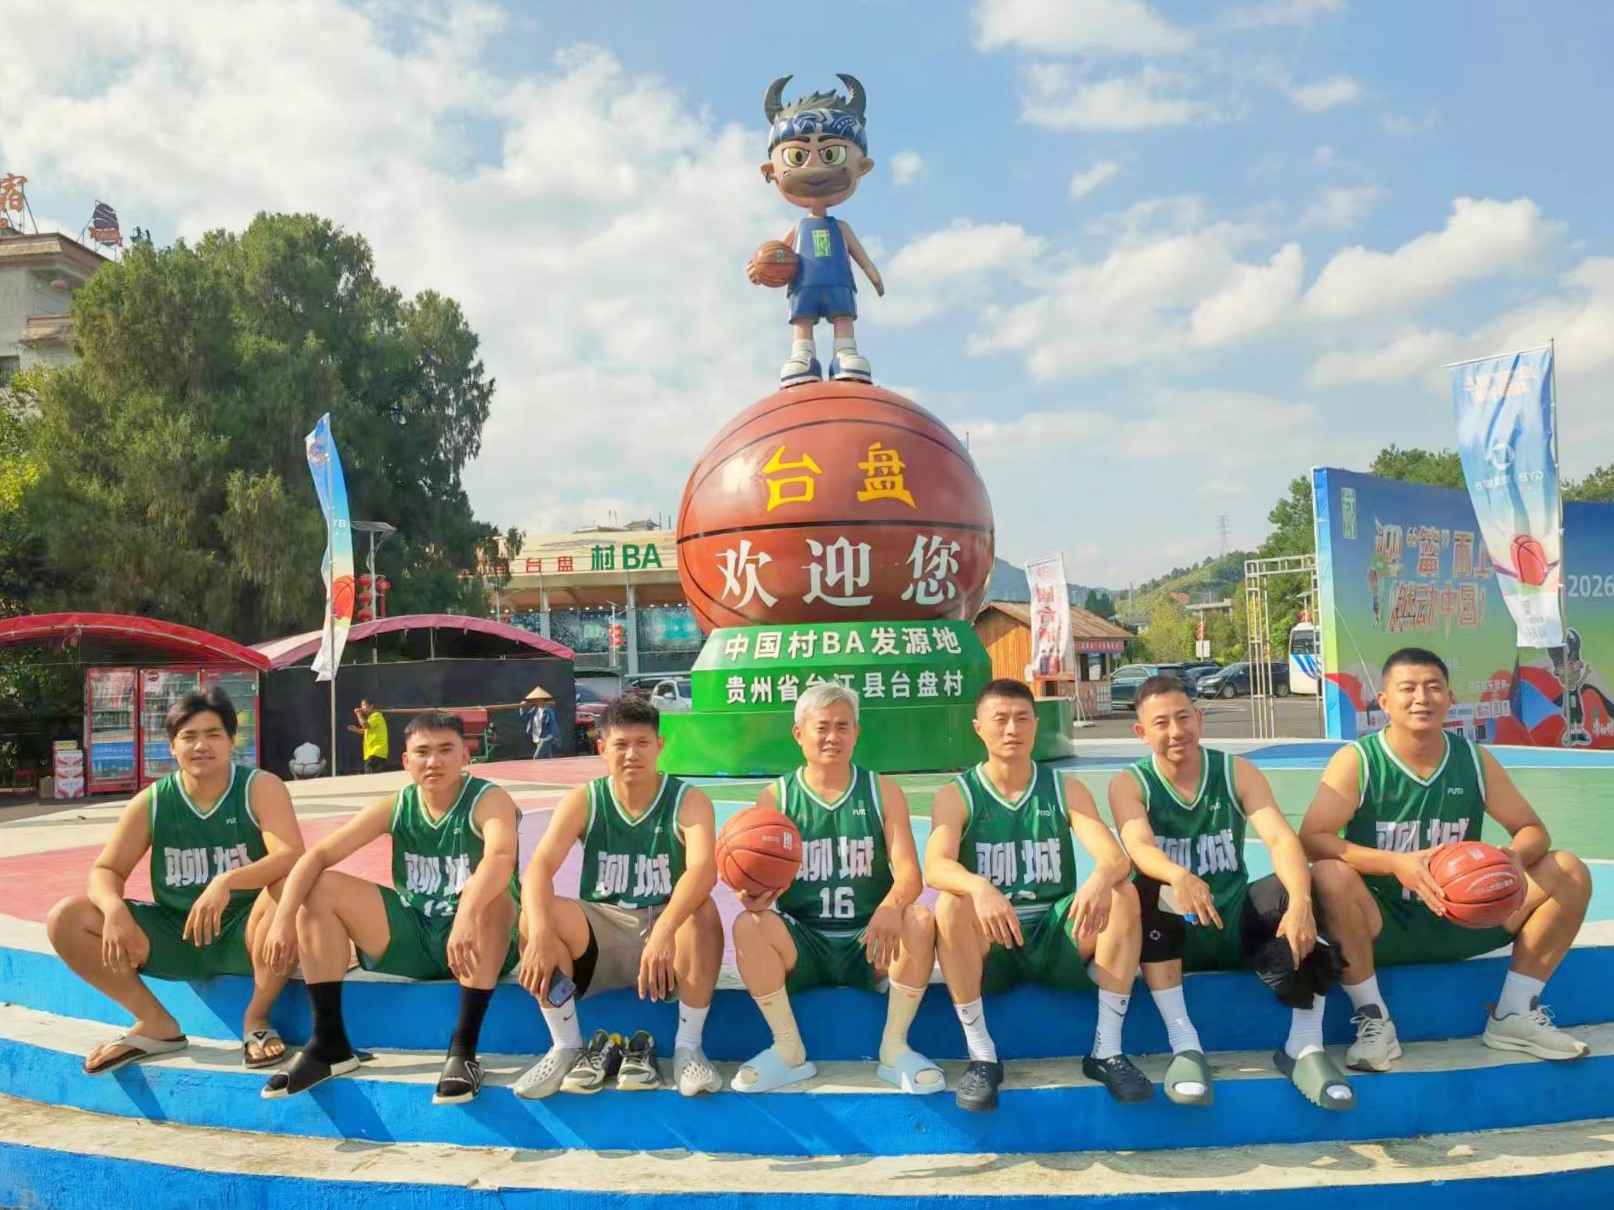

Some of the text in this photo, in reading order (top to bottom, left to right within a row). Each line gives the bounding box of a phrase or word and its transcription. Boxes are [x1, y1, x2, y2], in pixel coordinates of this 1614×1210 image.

[761, 442, 916, 511] 台盘
[591, 543, 662, 571] 村BA
[715, 534, 961, 609] 欢迎您
[1567, 574, 1614, 597] 2026
[724, 626, 962, 662] 中国村BA发源地
[595, 851, 673, 897] 聊城
[796, 836, 875, 882] 聊城
[975, 838, 1062, 887] 聊城
[819, 886, 856, 919] 16
